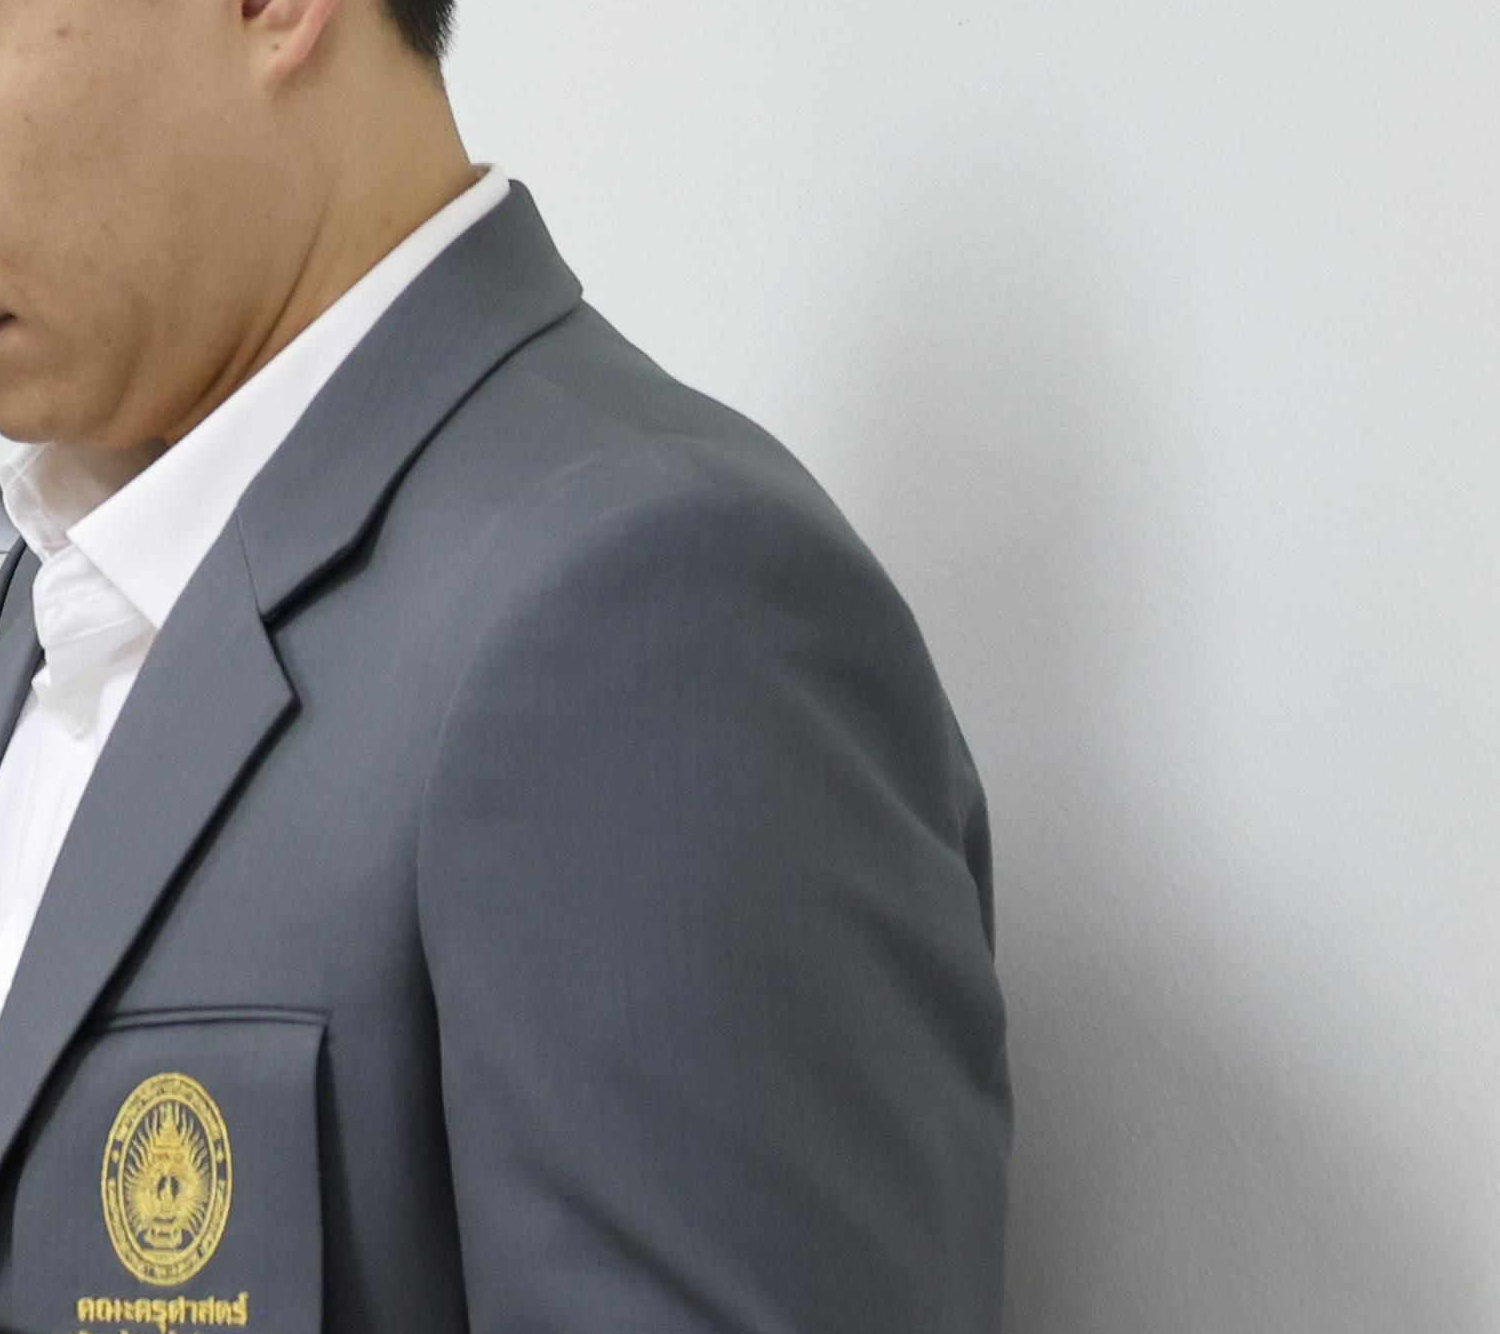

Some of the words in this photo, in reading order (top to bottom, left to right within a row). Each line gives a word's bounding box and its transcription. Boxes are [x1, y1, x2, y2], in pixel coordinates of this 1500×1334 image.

[76, 1290, 249, 1334] คณะครุศาสตร์
